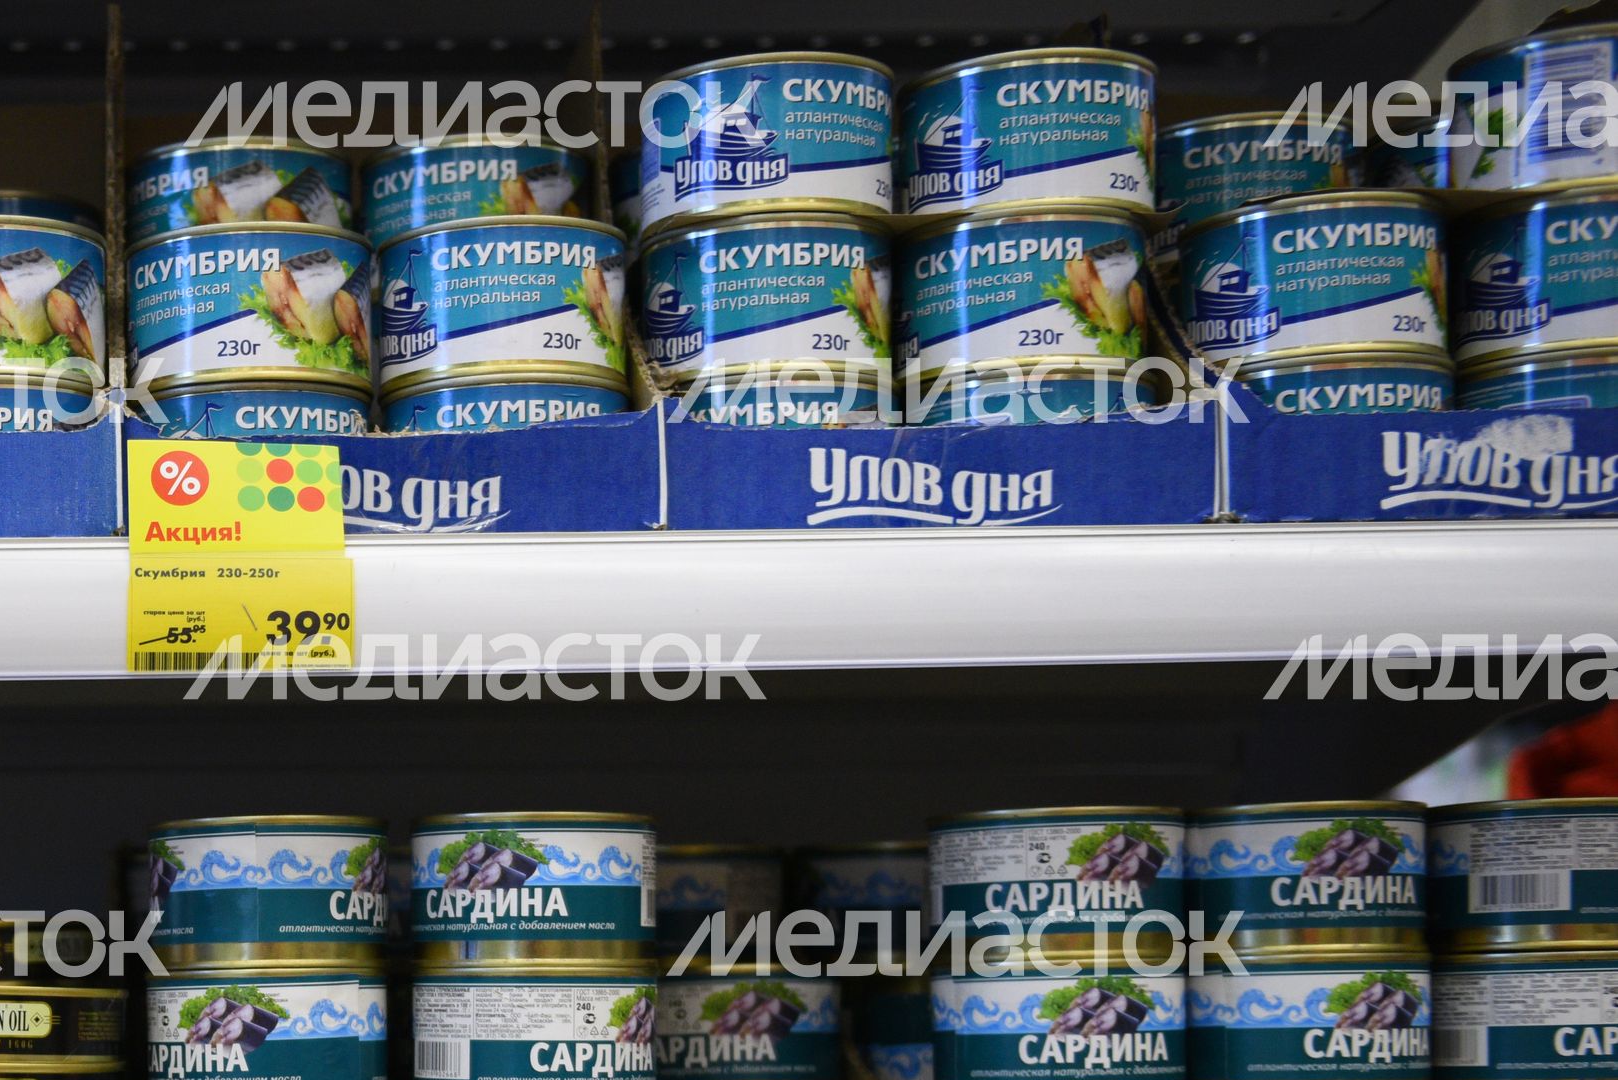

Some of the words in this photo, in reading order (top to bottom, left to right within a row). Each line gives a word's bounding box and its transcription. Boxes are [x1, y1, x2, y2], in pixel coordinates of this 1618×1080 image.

[996, 79, 1150, 113] СКУМБРИЯ
[998, 108, 1121, 129] атлантическая
[998, 126, 1109, 147] натуральная
[372, 159, 518, 199] СКУМБРИЯ
[1109, 173, 1140, 193] 230г
[1272, 222, 1438, 256] СКУМБРИЯ
[135, 247, 281, 290] СКУМБРИЯ
[432, 241, 597, 272] СКУМБРИЯ
[698, 243, 865, 275] СКУМБРИЯ
[914, 237, 1084, 281] СКУМБРИЯ
[1275, 254, 1405, 275] атлантическая
[433, 273, 556, 293] атлантическая
[700, 272, 826, 294] атлантическая
[1275, 272, 1392, 293] натуральная
[135, 280, 231, 311] атлантическая
[433, 288, 541, 310] натуральная
[701, 290, 810, 312] натуральная
[135, 300, 215, 328] натуральная
[1392, 314, 1427, 333] 230г
[217, 339, 261, 358] 230г
[542, 331, 583, 351] 230г
[811, 332, 851, 352] 230г
[1017, 328, 1065, 348] 230г
[1275, 384, 1443, 413] СКУМБРИЯ
[145, 521, 241, 545] Акция!
[134, 567, 206, 580] Скумбрия
[217, 568, 281, 578] 230-250г
[984, 882, 1144, 917] САРДИНА
[1271, 876, 1416, 909] САРДИНА
[426, 887, 568, 924] САРДИНА
[9, 1008, 30, 1031] OIL
[1018, 1032, 1169, 1067] САРДИНА
[1303, 1028, 1430, 1063] САРДИНА
[529, 1042, 653, 1078] САРДИНА
